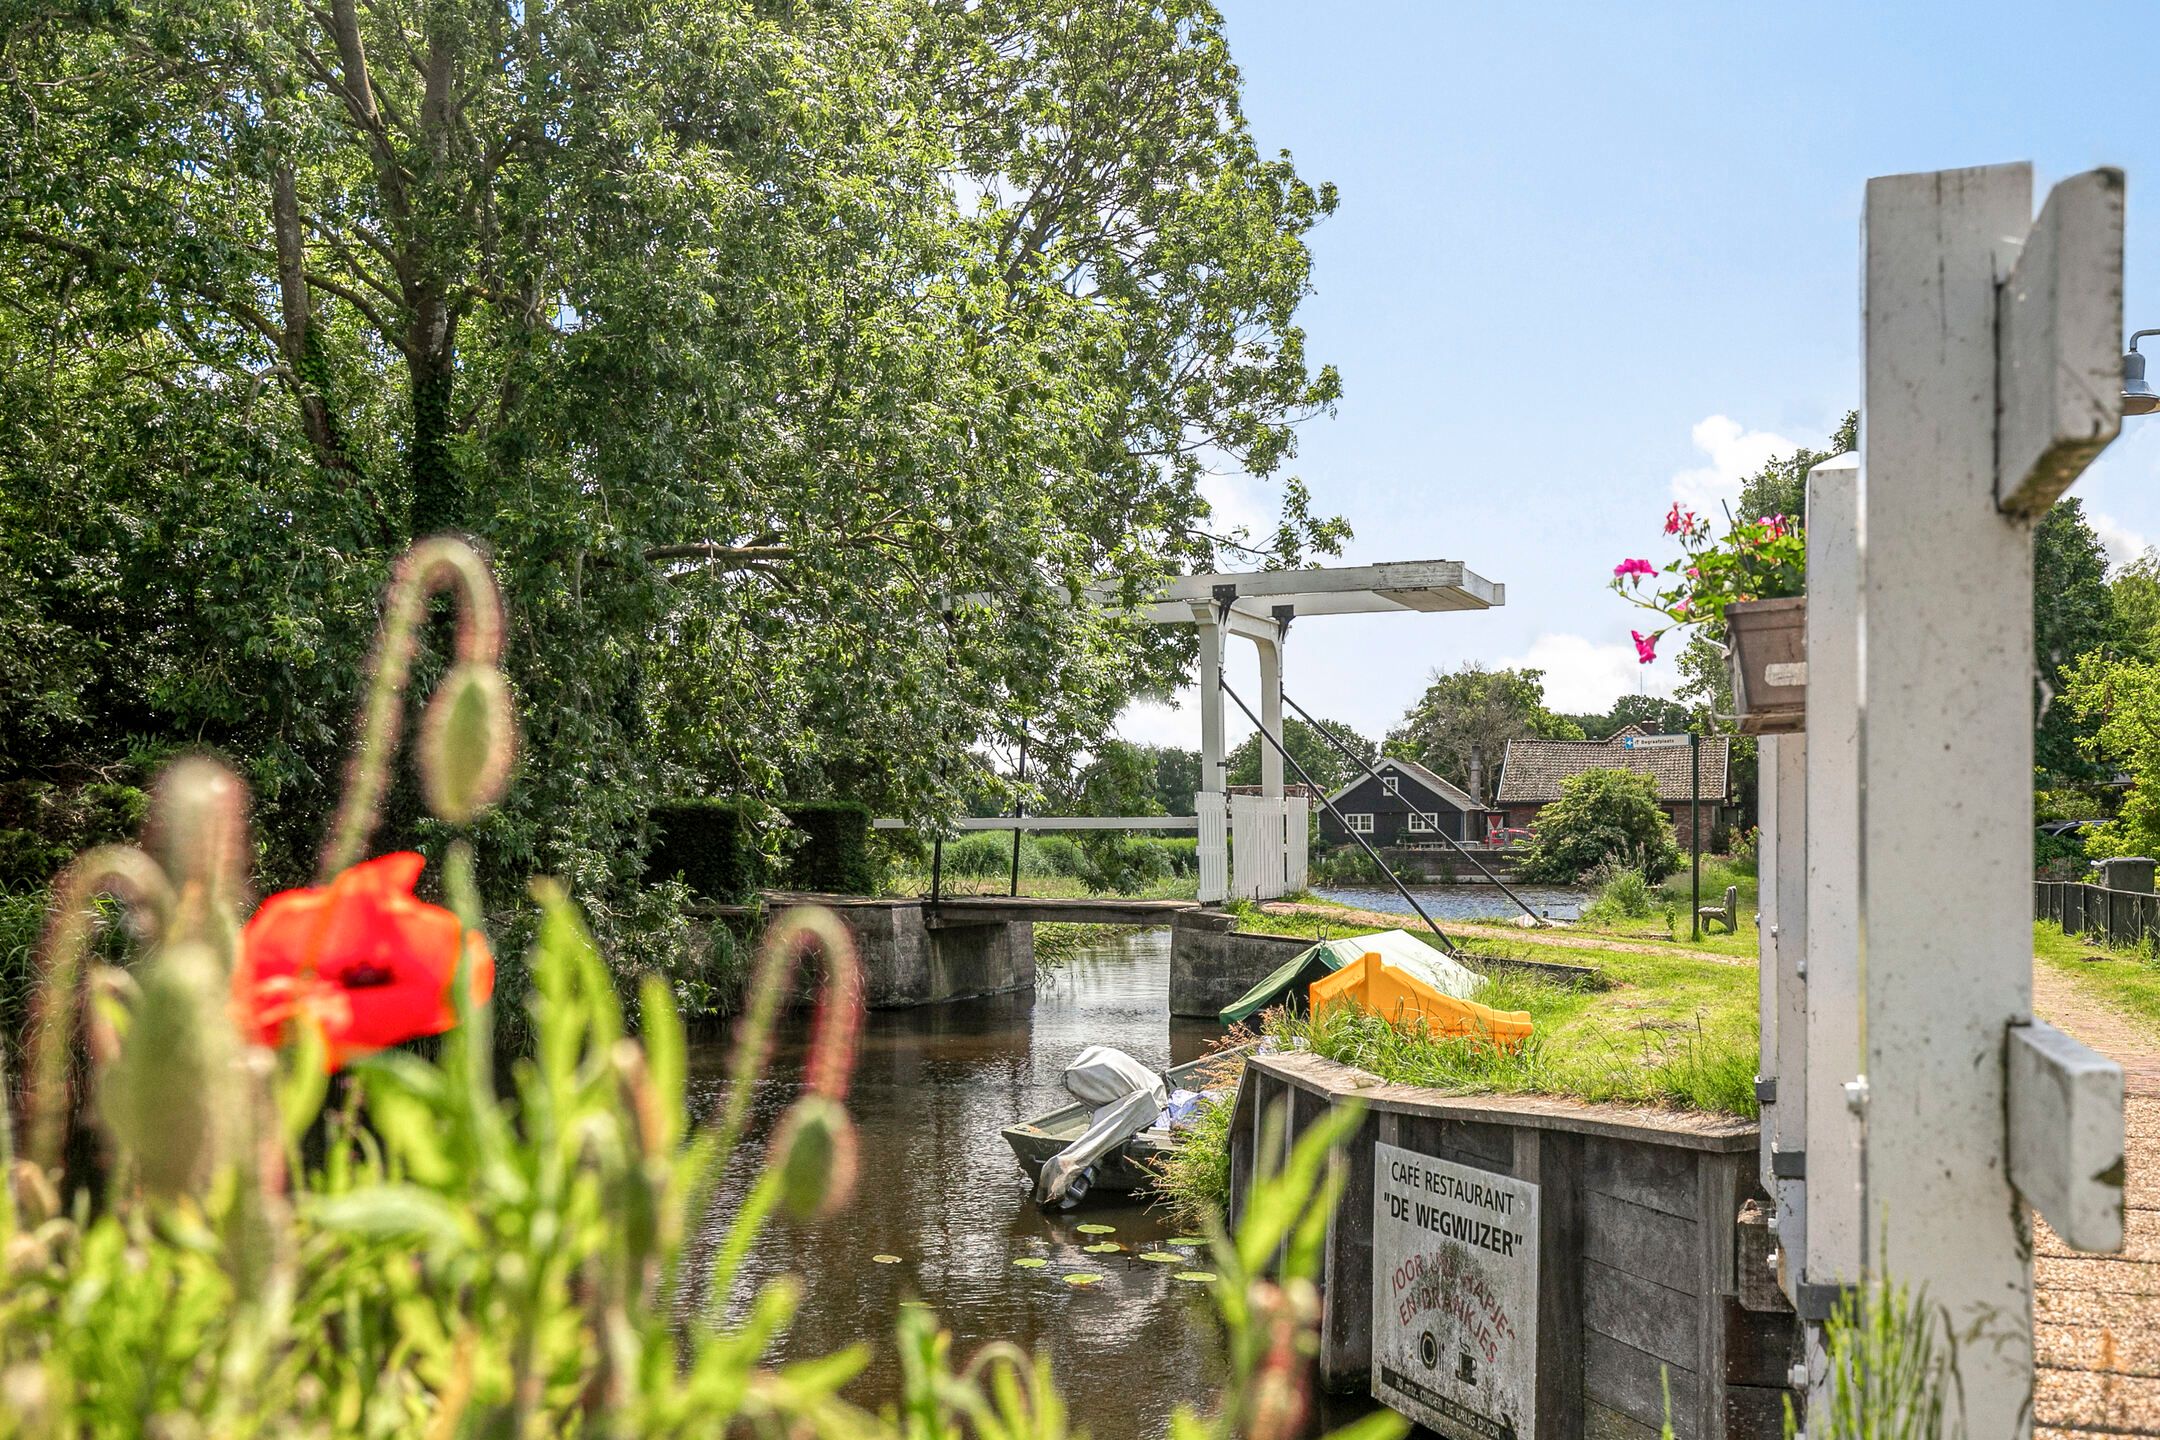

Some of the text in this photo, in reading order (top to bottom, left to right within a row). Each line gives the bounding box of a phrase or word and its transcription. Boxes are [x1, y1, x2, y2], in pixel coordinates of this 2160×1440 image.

[1391, 1161, 1514, 1215] CAFÉ RESTAURANT
[1384, 1192, 1523, 1257] "DE WEGWIJZER"
[1400, 1292, 1417, 1326] EN
[1444, 1401, 1455, 1416] DE
